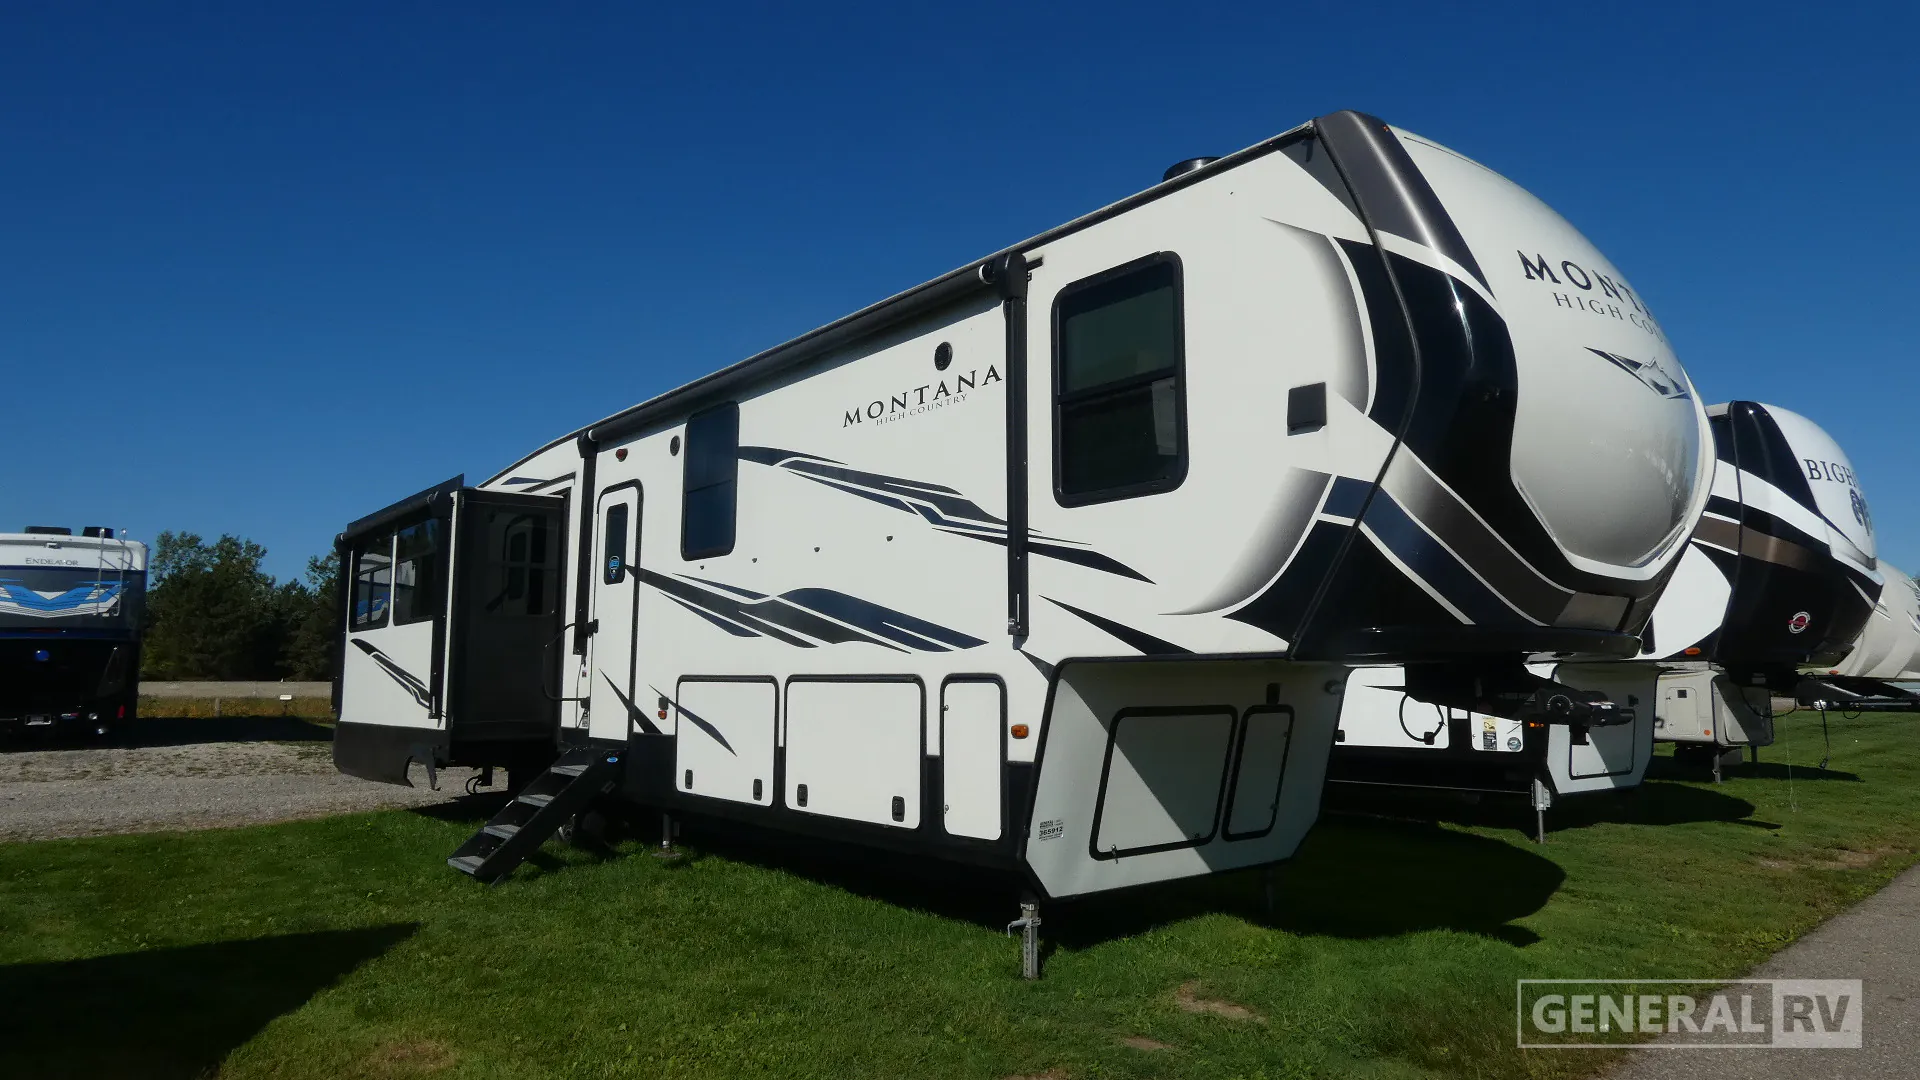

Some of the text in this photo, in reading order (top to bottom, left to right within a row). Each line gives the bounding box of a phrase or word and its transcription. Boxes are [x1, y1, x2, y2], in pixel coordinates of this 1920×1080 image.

[1553, 292, 1624, 321] HIGH
[843, 364, 1002, 428] MONTANA
[876, 393, 968, 426] HIGH COUNTRY
[1803, 458, 1858, 488] BIGH
